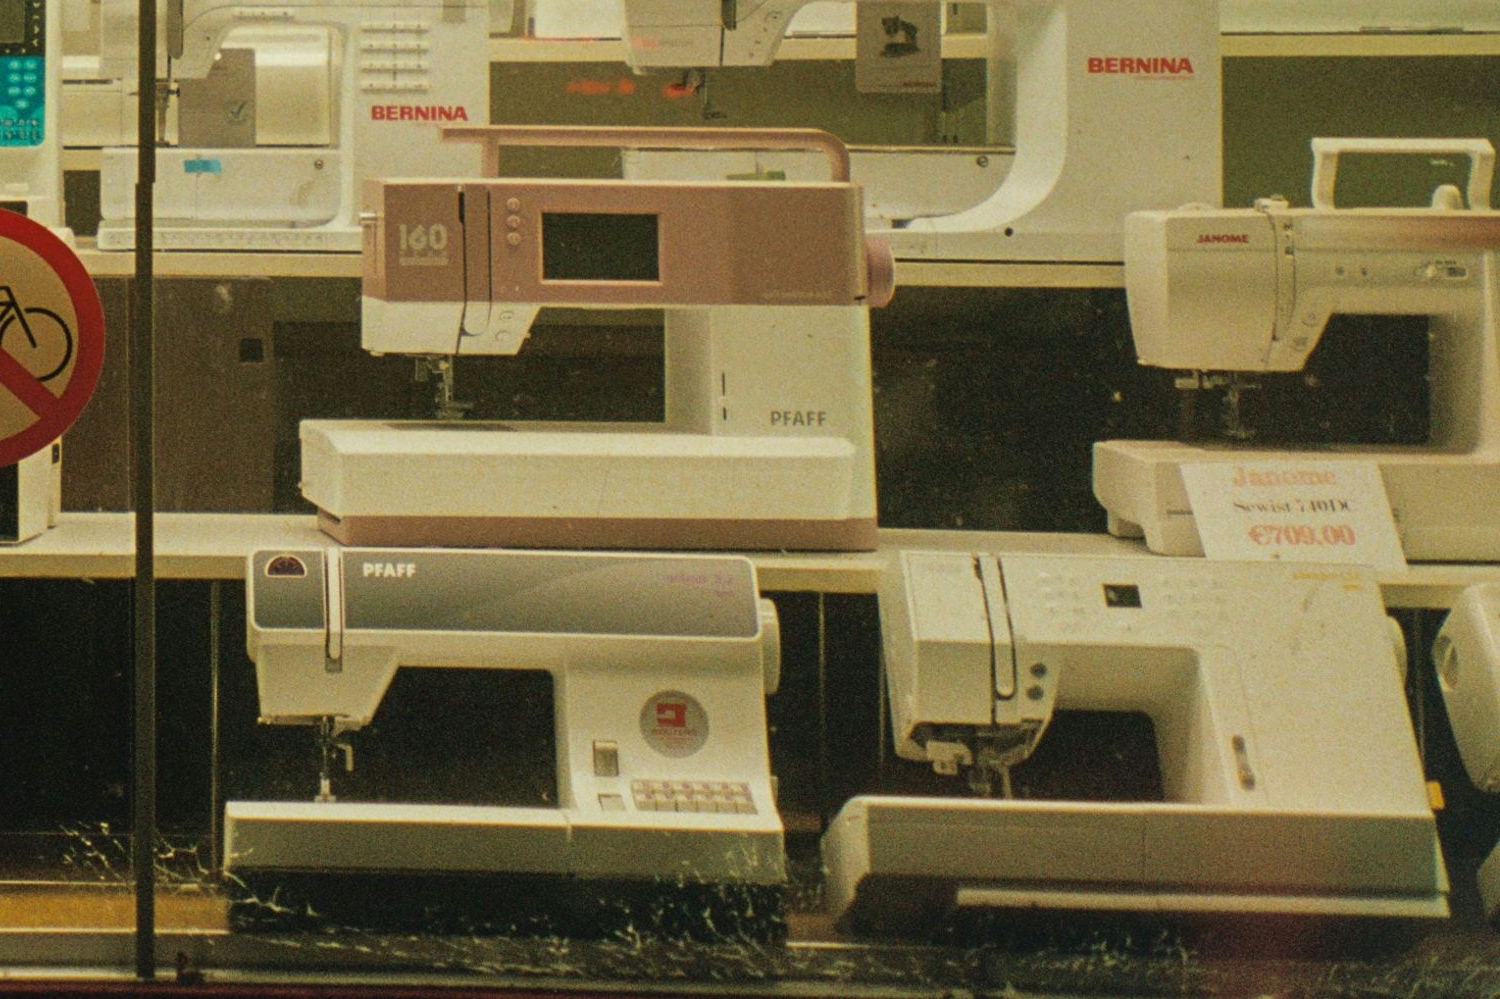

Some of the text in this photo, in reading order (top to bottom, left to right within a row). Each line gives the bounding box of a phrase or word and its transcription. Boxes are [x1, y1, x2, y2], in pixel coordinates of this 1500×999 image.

[1086, 56, 1195, 74] BERNINA
[371, 105, 469, 122] BERNINA
[398, 223, 448, 250] 160
[1196, 234, 1250, 244] JANOME
[770, 410, 828, 426] PFAFF
[1233, 465, 1336, 488] Janome
[361, 562, 417, 579] PFAFF
